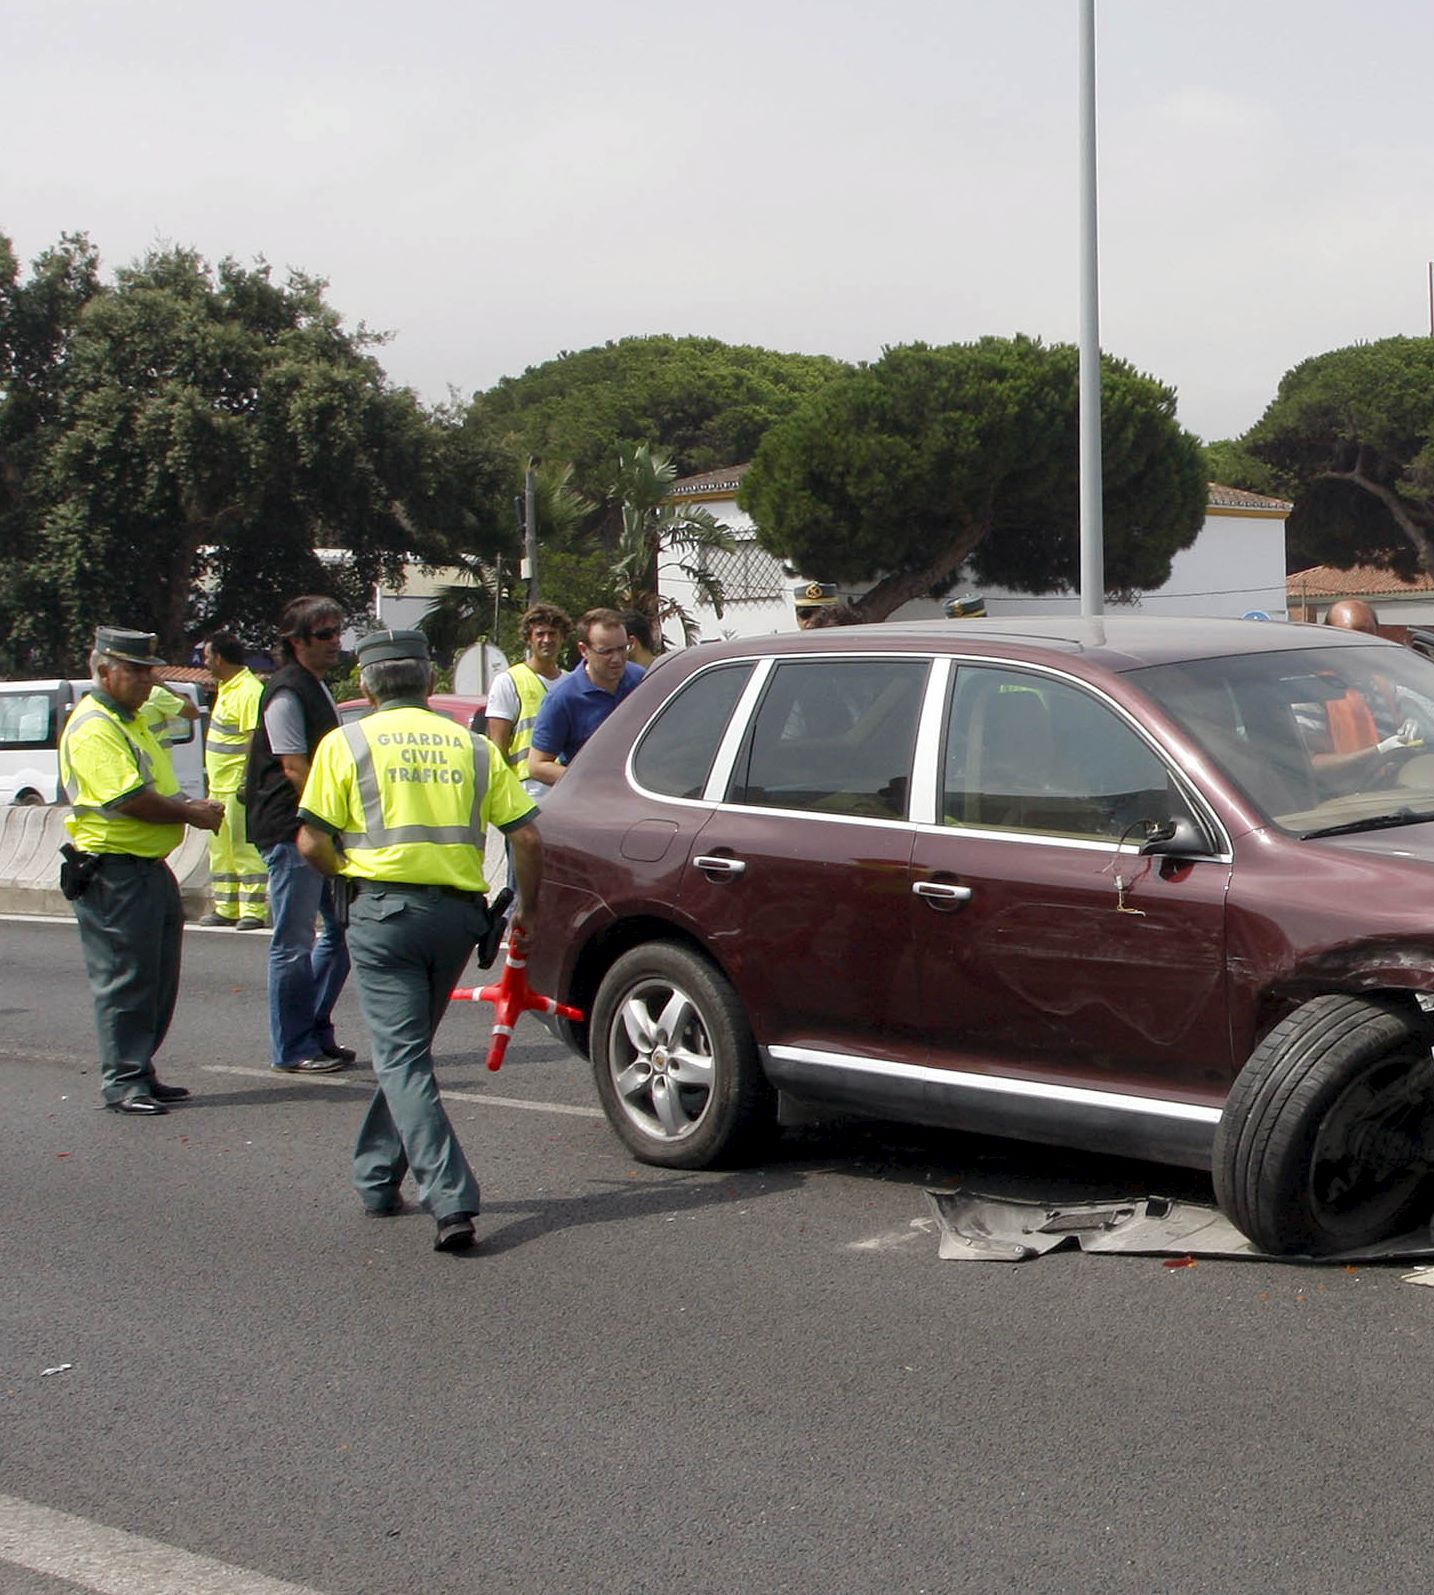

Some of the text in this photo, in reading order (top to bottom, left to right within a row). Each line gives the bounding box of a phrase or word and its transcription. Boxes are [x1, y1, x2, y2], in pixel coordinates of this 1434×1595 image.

[377, 733, 464, 749] GUARDIA
[401, 749, 448, 764] CIVIL
[388, 767, 463, 784] TRAFICO
